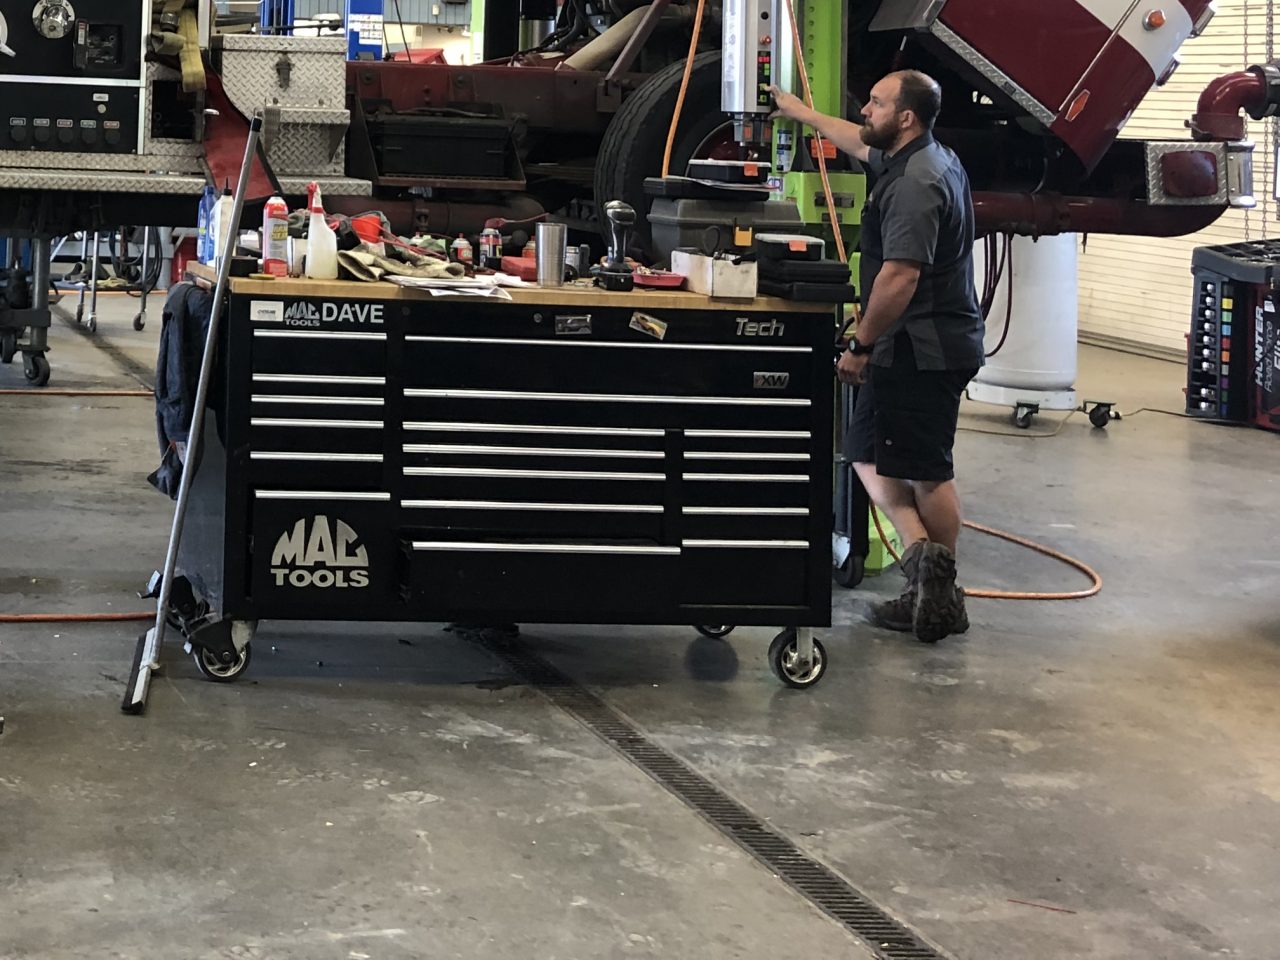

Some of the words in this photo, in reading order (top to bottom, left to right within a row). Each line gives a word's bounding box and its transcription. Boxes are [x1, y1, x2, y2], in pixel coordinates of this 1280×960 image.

[284, 301, 321, 319] MAC
[322, 302, 385, 324] DAVE
[284, 319, 321, 327] TOOLS
[735, 317, 785, 337] Tech
[1255, 305, 1264, 386] HUNTER
[271, 514, 369, 567] MAC
[270, 568, 370, 588] TOOLS
